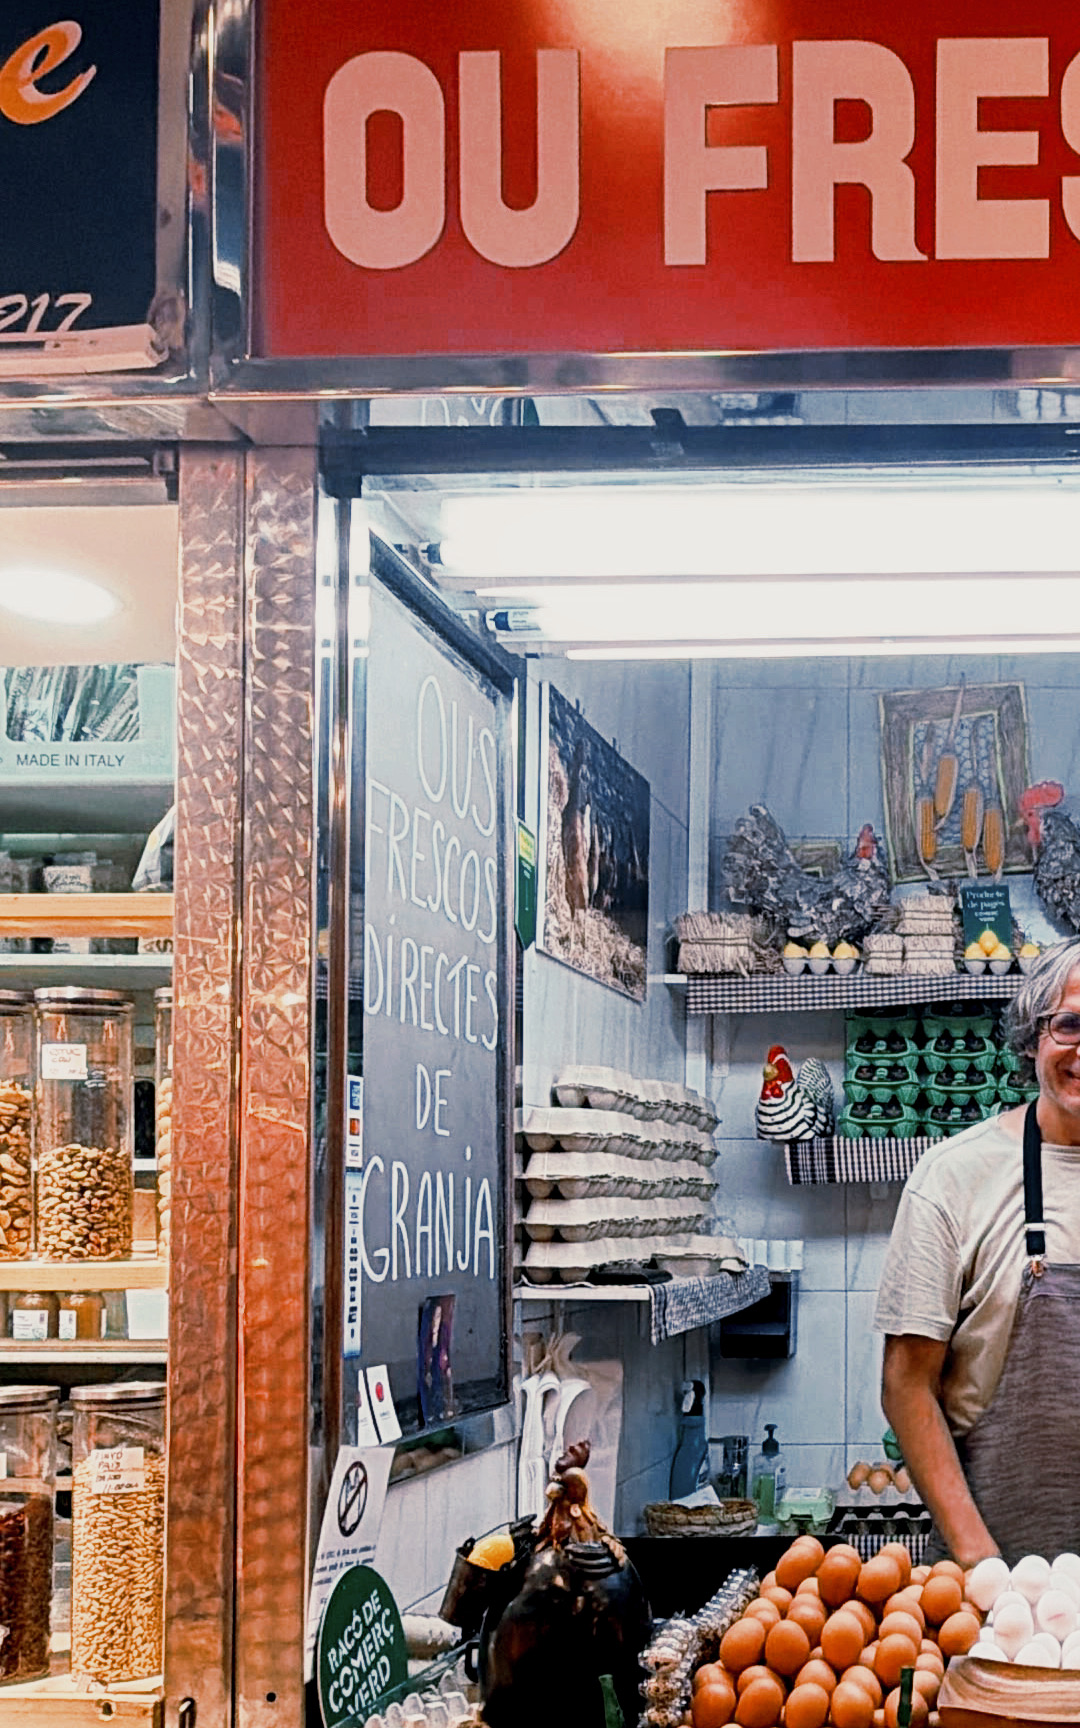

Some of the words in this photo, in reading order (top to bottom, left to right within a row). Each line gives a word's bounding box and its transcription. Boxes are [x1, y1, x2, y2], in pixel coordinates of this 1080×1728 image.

[323, 49, 580, 270] OU
[0, 293, 92, 332] 217
[16, 753, 60, 767] MADE
[64, 753, 80, 767] IN
[84, 753, 125, 767] ITALY
[416, 675, 496, 837] OUS
[365, 778, 497, 944] FRESCOS
[364, 914, 498, 1051] DIRECTES
[416, 1063, 451, 1136] DE
[361, 1146, 495, 1283] GRANJA
[327, 1609, 363, 1674] RACÓ
[362, 1588, 381, 1626] DE
[329, 1608, 394, 1713] COMERÇ
[346, 1655, 391, 1715] VERD
